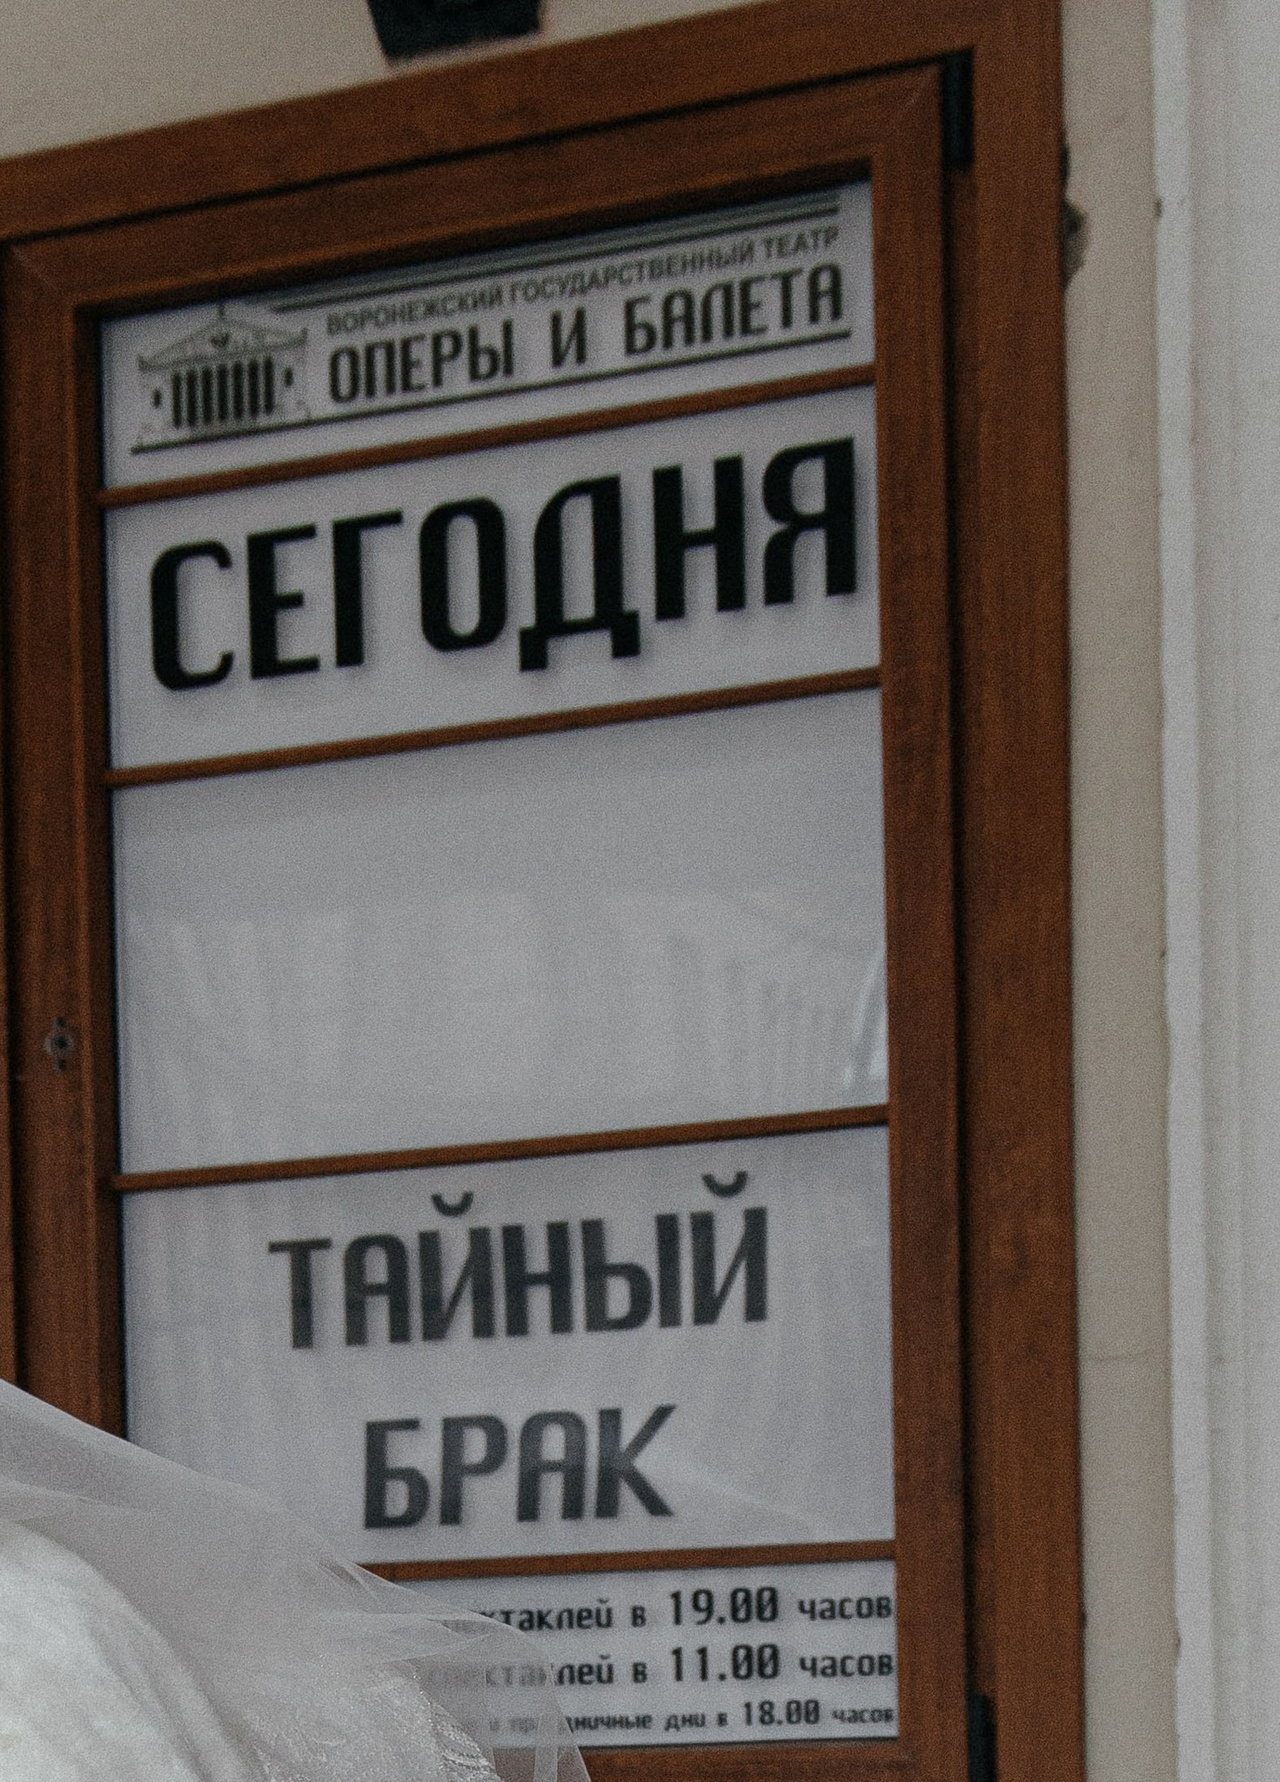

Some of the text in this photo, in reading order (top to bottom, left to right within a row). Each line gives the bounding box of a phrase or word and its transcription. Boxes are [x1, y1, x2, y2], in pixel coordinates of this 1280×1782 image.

[326, 224, 840, 336] ВОРОНЕЖСКИЙ ГОСУДАРСТВЕННЫЙ ТЕАТР
[329, 262, 844, 403] ОПЕРЫ И БАЛЕТА
[149, 437, 858, 691] СЕГОДНЯ
[268, 1170, 770, 1350] ТАЙНЫЙ
[362, 1404, 677, 1530] БРАК
[631, 1604, 647, 1628] в
[671, 1586, 779, 1626] 19.00
[797, 1595, 893, 1621] часов
[632, 1661, 648, 1684] в
[672, 1643, 780, 1682] 11.00
[799, 1653, 894, 1678] часов
[664, 1712, 706, 1732] дни
[716, 1712, 728, 1727] в
[743, 1699, 820, 1726] 18.00
[830, 1706, 894, 1724] часов
